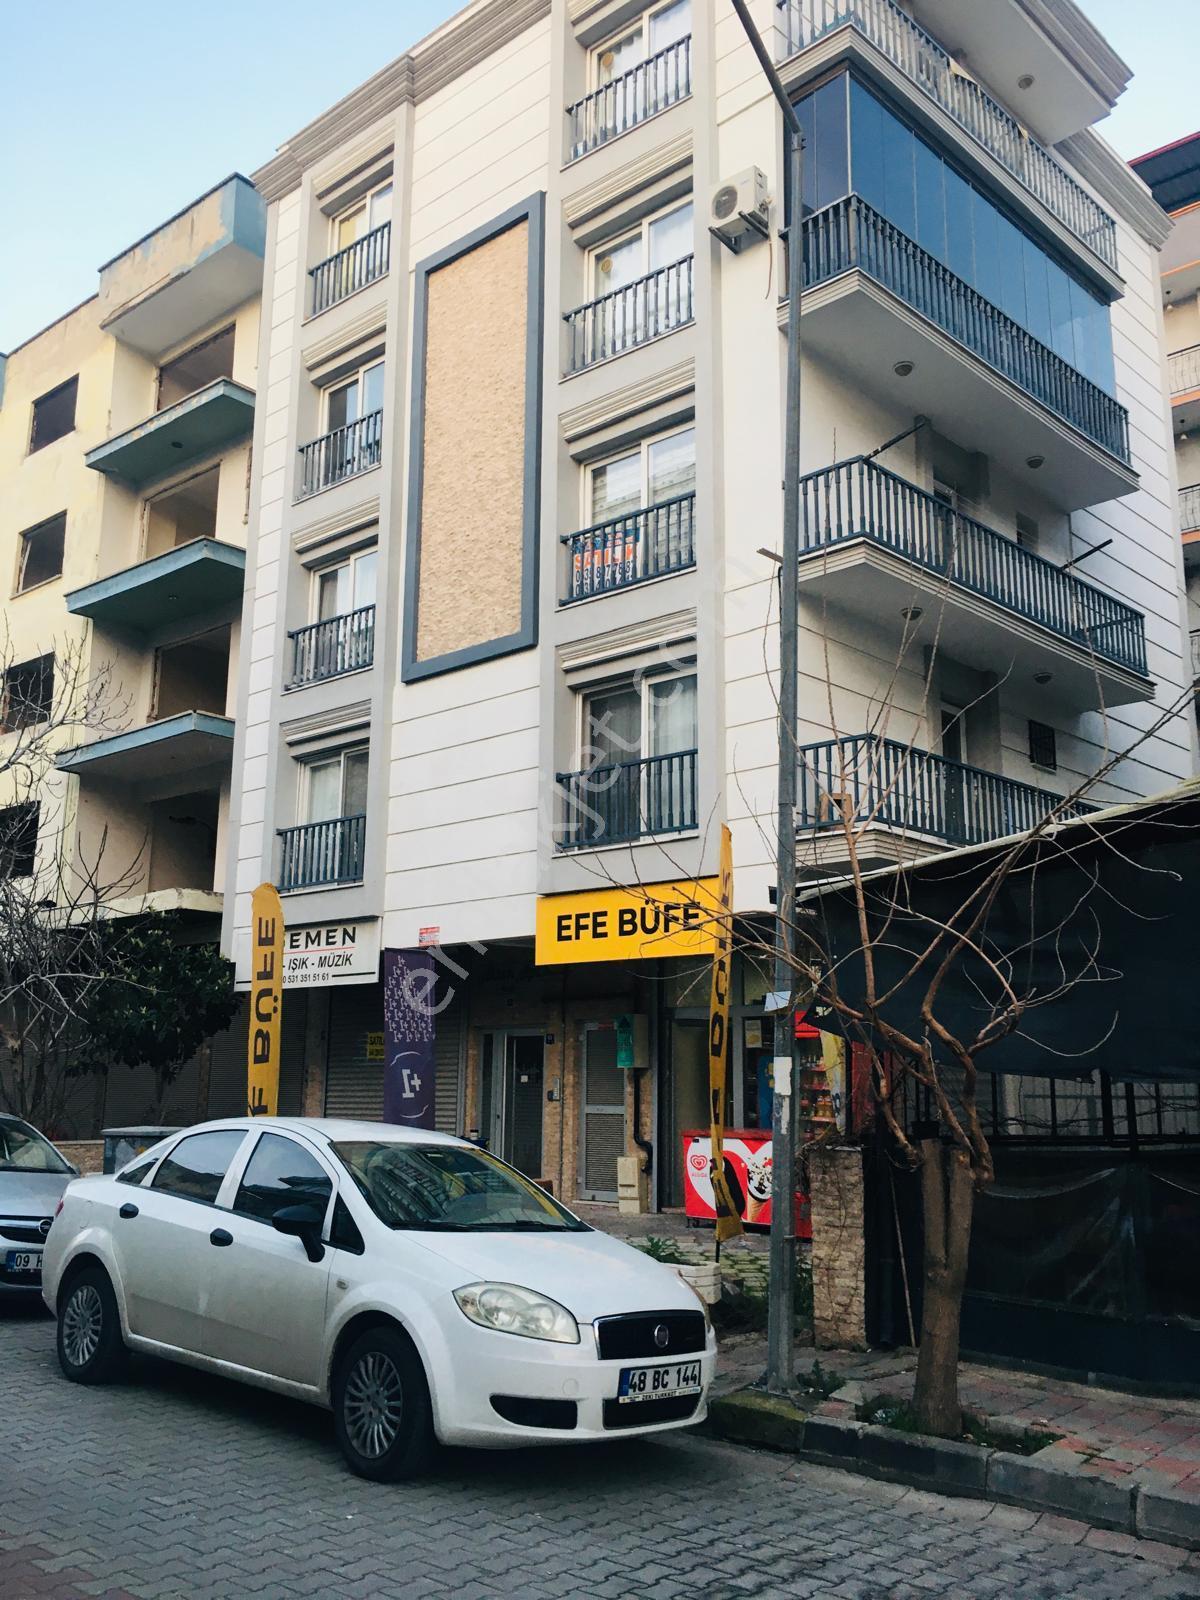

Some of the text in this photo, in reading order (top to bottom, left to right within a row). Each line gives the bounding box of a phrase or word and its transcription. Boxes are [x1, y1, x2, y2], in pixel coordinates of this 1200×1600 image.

[557, 899, 700, 942] EFE BÜFE
[288, 957, 309, 973] IŞIK
[318, 951, 353, 968] MÜZİK
[288, 974, 299, 983] 531
[300, 973, 311, 982] 351
[313, 972, 320, 982] 51
[322, 971, 329, 981] 61
[15, 1254, 30, 1268] 09
[628, 1364, 697, 1393] 48 BC 144
